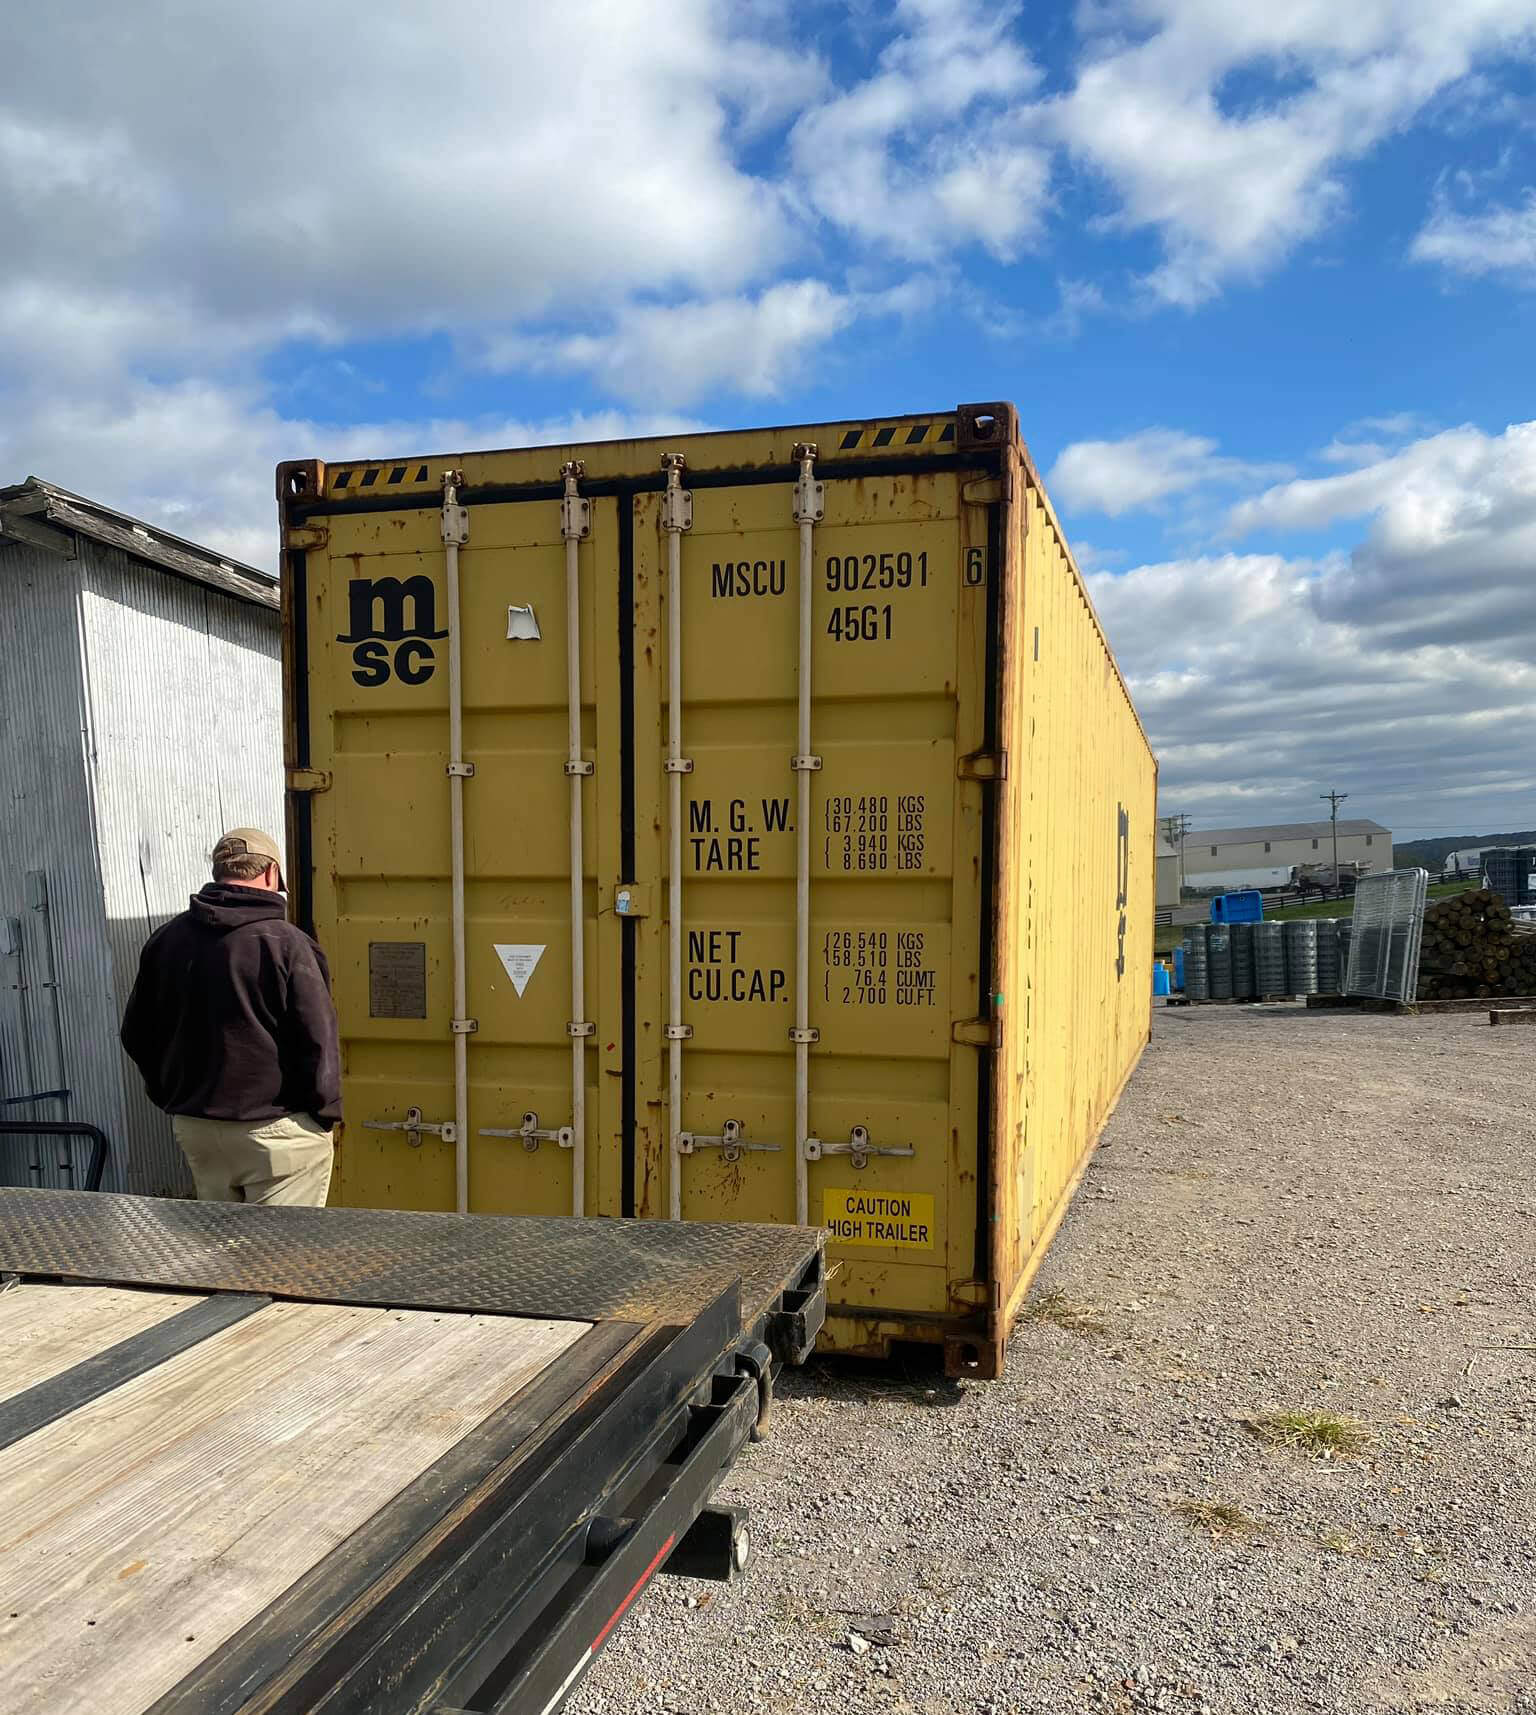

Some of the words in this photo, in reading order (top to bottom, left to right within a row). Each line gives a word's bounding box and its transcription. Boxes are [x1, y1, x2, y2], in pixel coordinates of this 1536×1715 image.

[711, 560, 786, 598] MSCU
[826, 552, 928, 592] 902591
[966, 548, 983, 585] 6
[827, 605, 892, 642] 45G1
[833, 797, 888, 814] 30.480
[898, 796, 924, 814] KGS
[833, 815, 888, 832] 67.200
[898, 815, 922, 832] LBS
[843, 834, 888, 852] 3.940
[897, 834, 924, 851] KGS
[690, 838, 760, 871] TARE
[843, 853, 887, 870] 8.690
[897, 853, 922, 870] LBS
[689, 931, 741, 964] NET
[833, 932, 887, 949] 26.540
[897, 933, 924, 950] KGS
[833, 950, 887, 967] 58.510
[896, 951, 921, 968] LBS
[688, 968, 788, 1002] CU.CAP.
[854, 970, 886, 987] 76.4
[843, 987, 886, 1004] 2.700
[846, 1197, 910, 1216] CAUTION
[828, 1219, 862, 1238] HIGH
[867, 1222, 928, 1242] TRAILER
